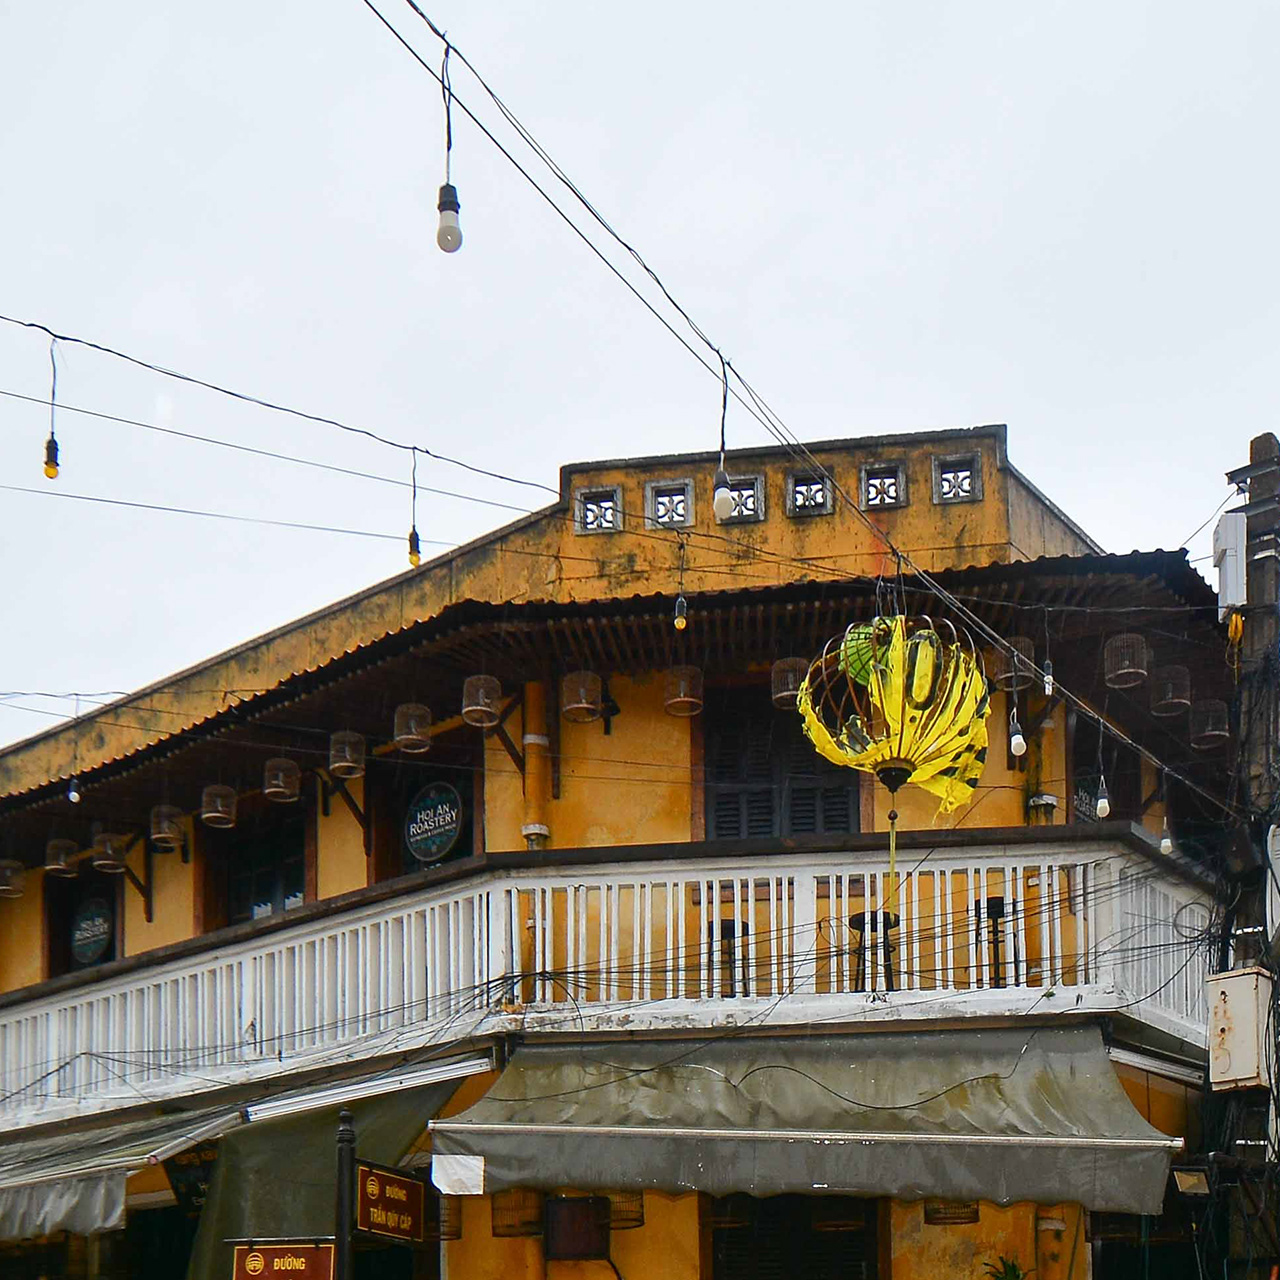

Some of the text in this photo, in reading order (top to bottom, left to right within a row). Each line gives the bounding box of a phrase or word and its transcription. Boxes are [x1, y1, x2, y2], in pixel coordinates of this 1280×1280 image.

[410, 808, 457, 836] ROASTERY
[417, 802, 450, 823] HOI AN
[273, 1253, 306, 1270] ĐƯỜNG
